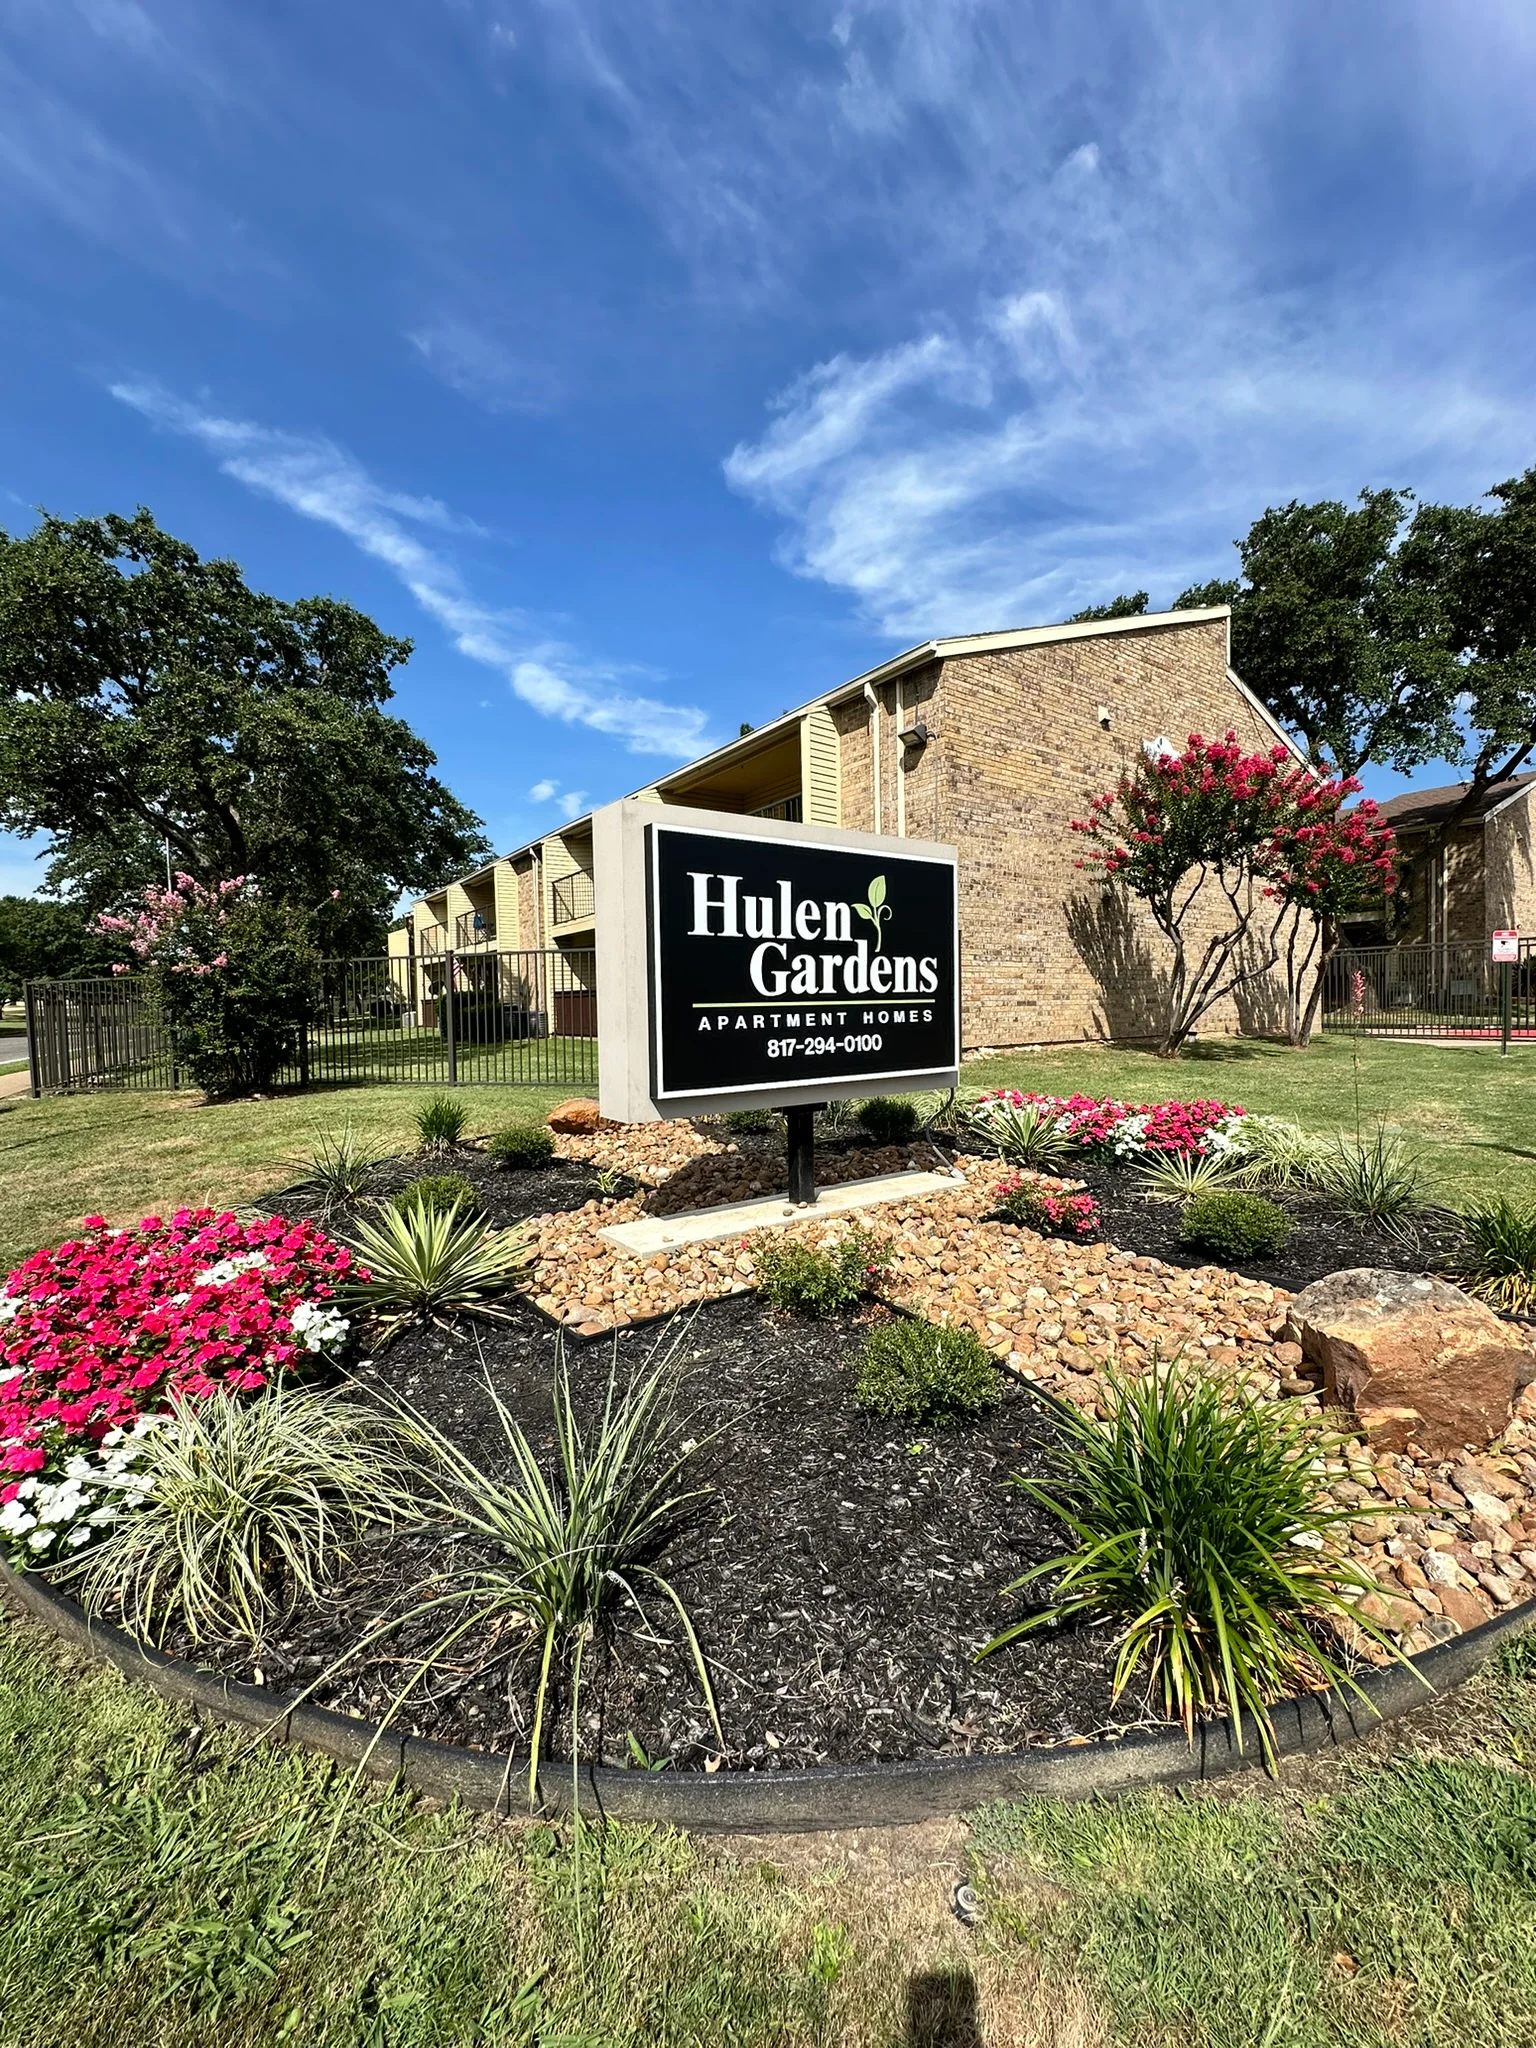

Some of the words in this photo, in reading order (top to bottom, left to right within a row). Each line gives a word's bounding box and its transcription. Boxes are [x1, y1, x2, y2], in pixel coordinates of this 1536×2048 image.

[686, 871, 854, 942] Hulen
[749, 939, 939, 997] Gardens
[697, 1012, 848, 1031] APARTMENT
[862, 1009, 933, 1025] HOMES
[767, 1033, 883, 1058] 817-294-0100
